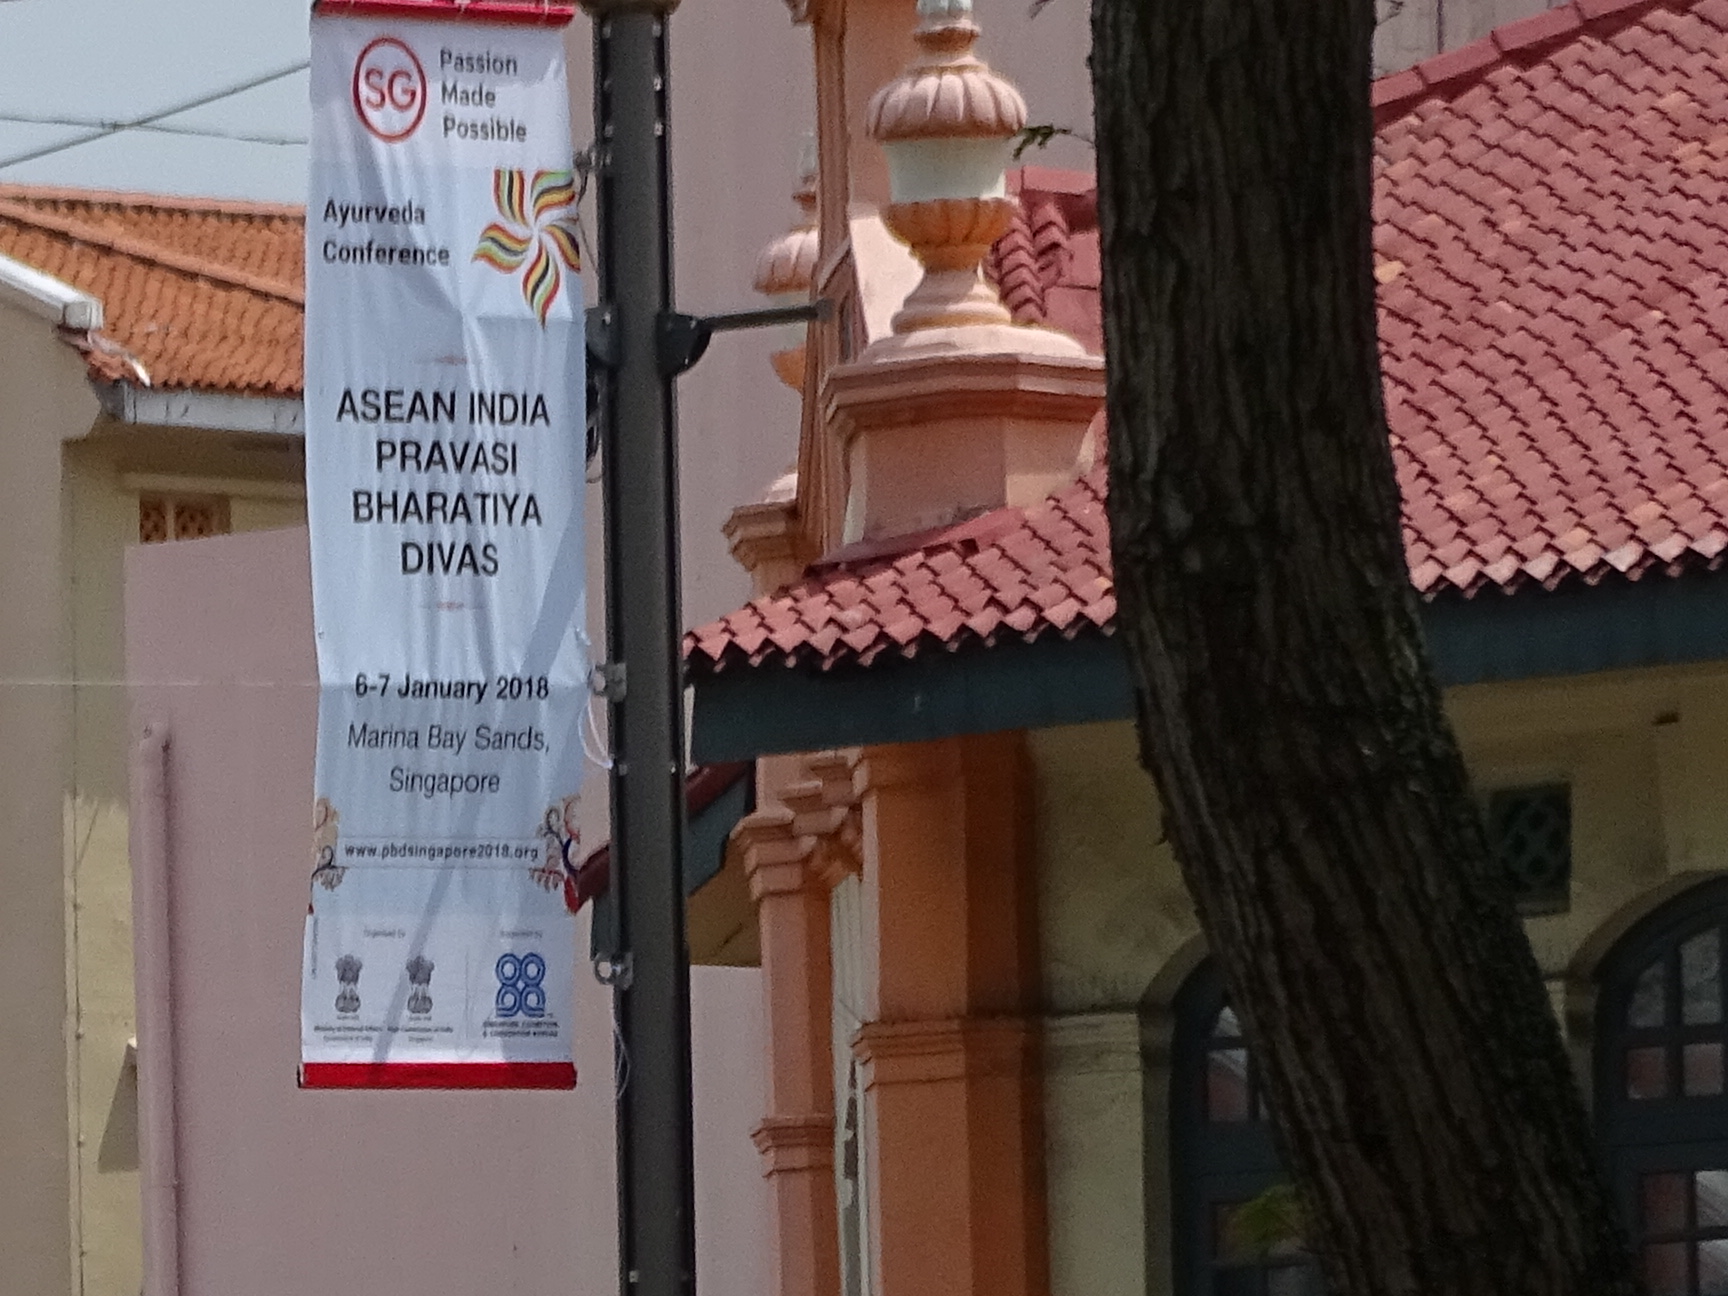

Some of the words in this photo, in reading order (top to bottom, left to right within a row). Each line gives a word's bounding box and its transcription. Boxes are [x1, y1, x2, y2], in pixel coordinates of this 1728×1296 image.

[439, 49, 518, 75] Passion
[363, 69, 418, 113] SG
[441, 83, 497, 109] Made
[443, 116, 528, 142] Possible
[322, 199, 426, 228] Ayurveda
[322, 242, 450, 267] Conference
[336, 387, 457, 424] ASEAN
[469, 390, 551, 427] INDIA
[375, 439, 518, 476] PRAVASI
[352, 489, 543, 527] BHARATIYA
[401, 541, 499, 577] DIVAS
[354, 673, 390, 699] 6-7
[397, 672, 488, 704] January
[496, 673, 550, 700] 2018
[347, 721, 420, 750] Marina
[427, 723, 468, 755] Bay
[474, 723, 550, 755] Sands,
[389, 768, 501, 800] Singapore
